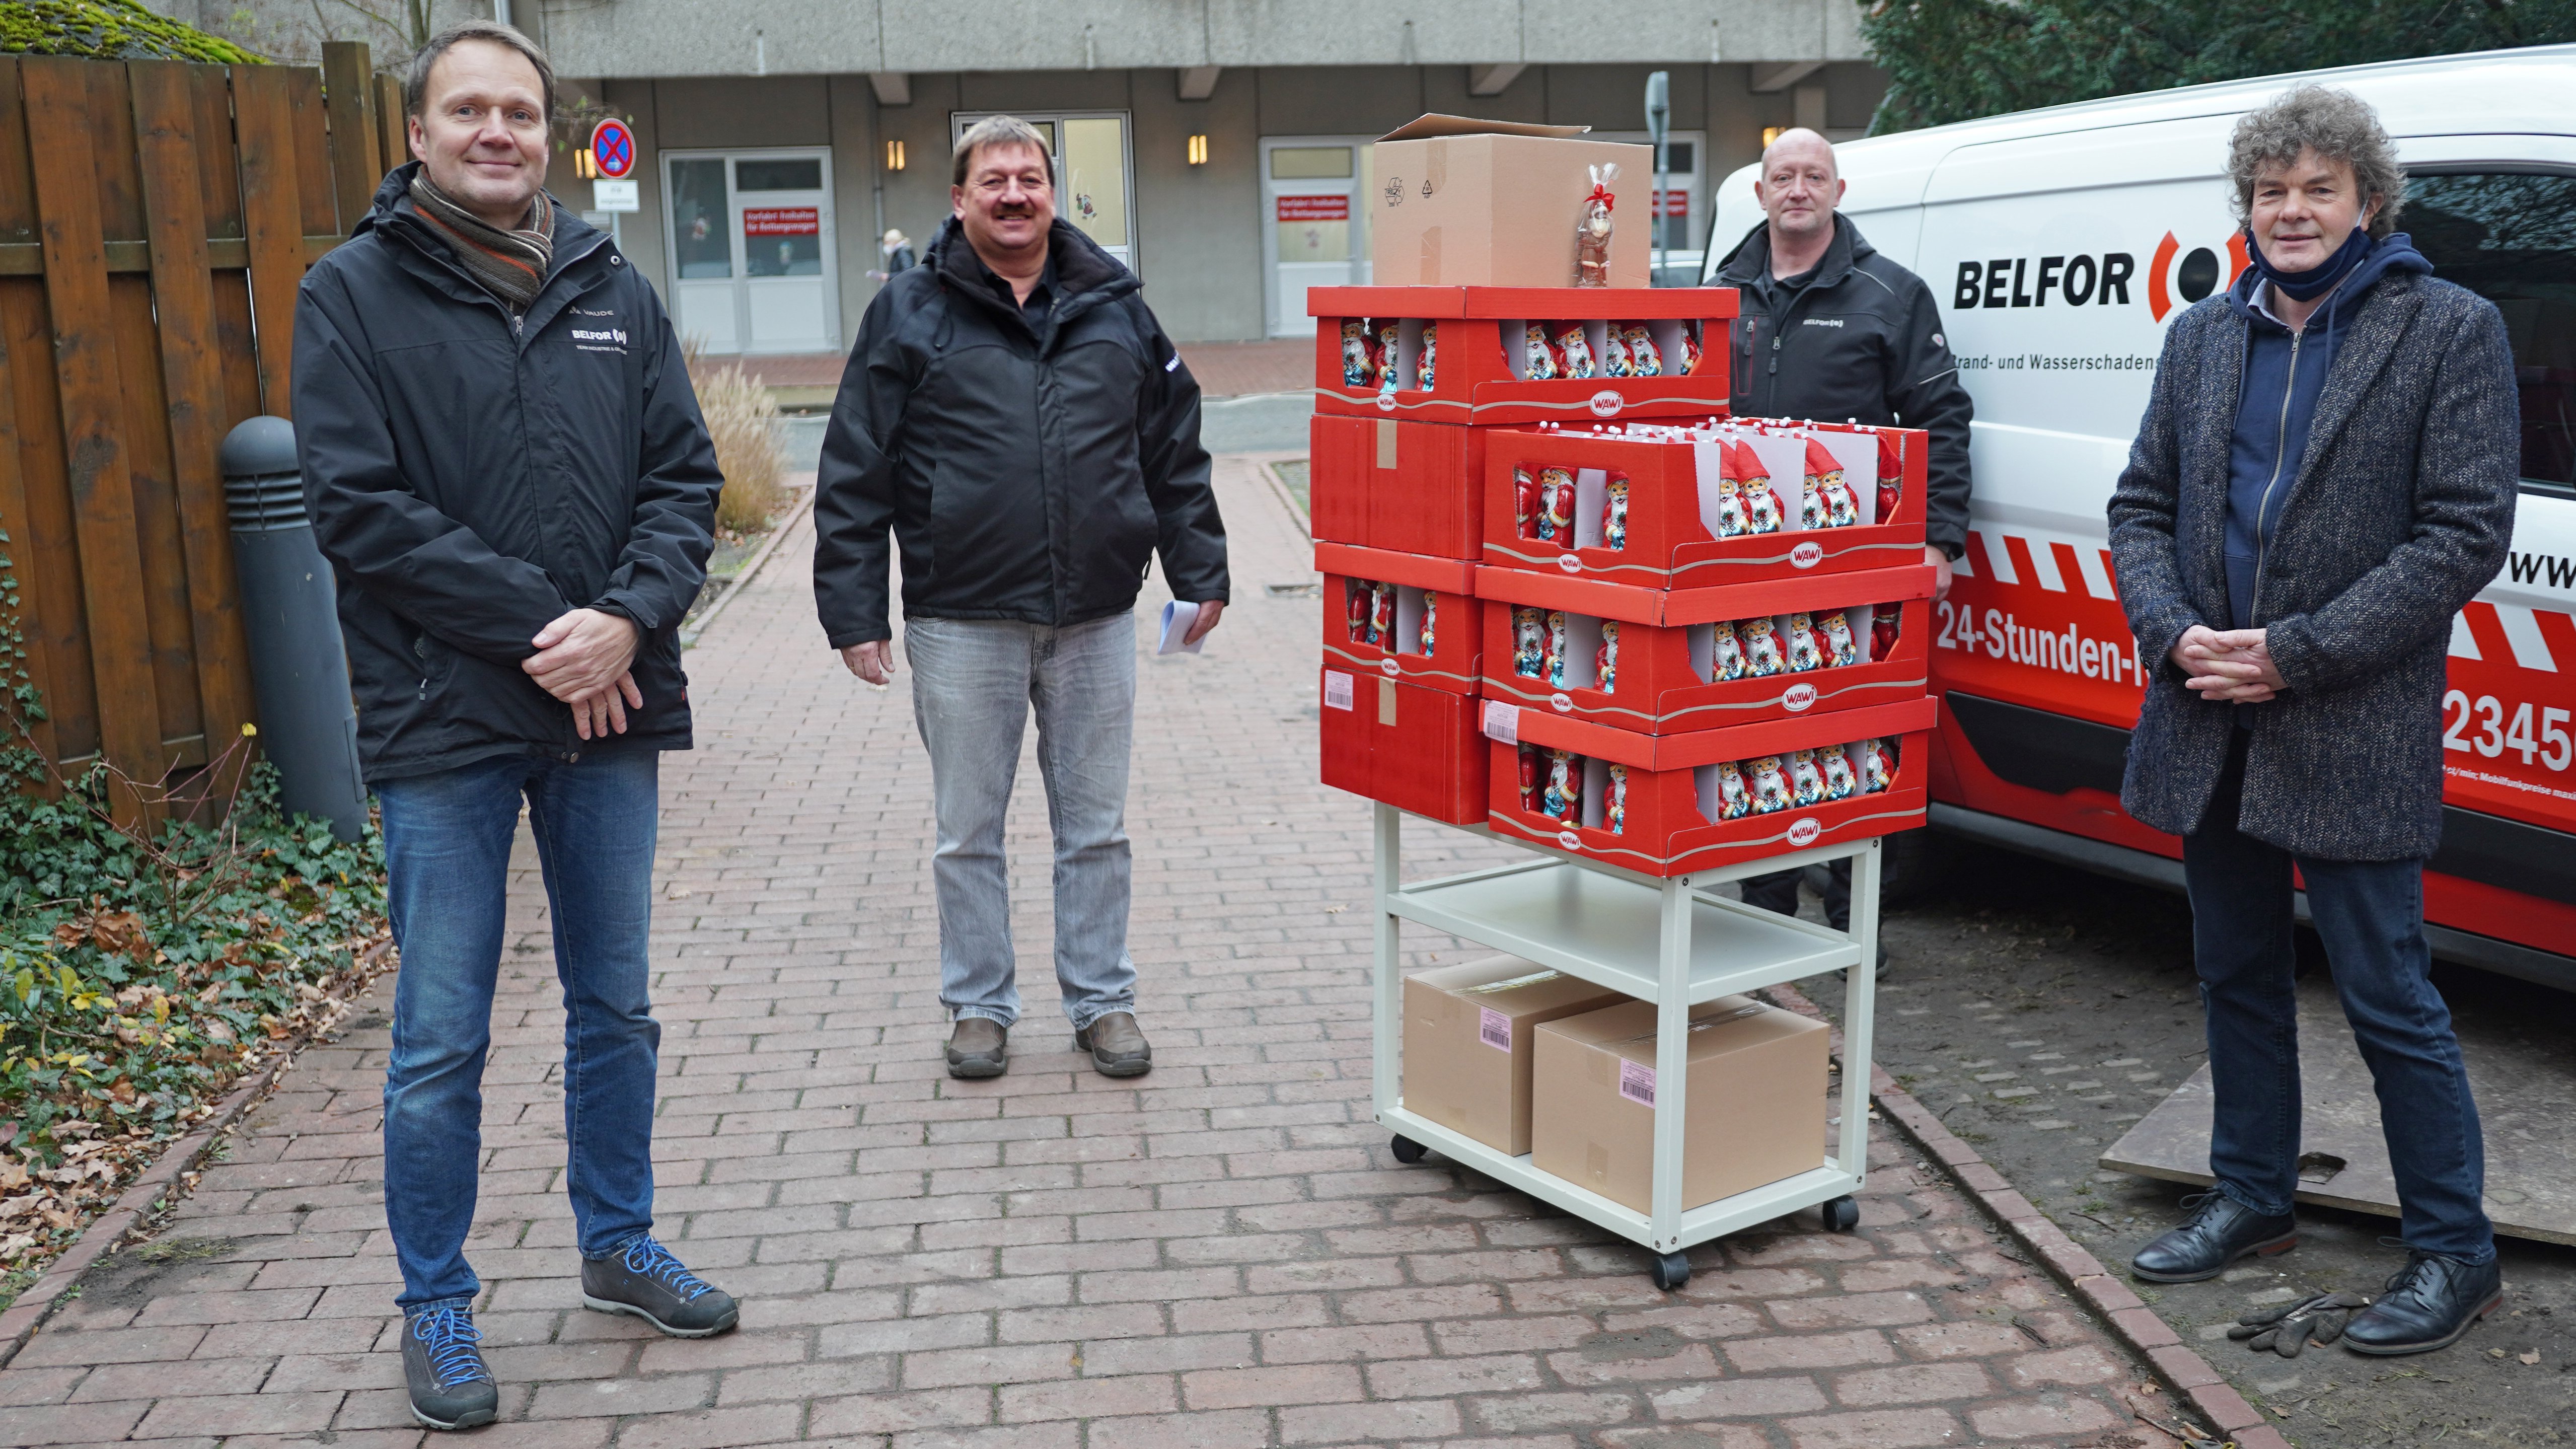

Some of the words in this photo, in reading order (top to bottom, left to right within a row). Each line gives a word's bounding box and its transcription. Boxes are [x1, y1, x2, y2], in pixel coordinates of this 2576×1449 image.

[1953, 252, 2135, 309] BELFOR
[571, 330, 613, 340] BELFOR
[1999, 354, 2024, 369] und
[2480, 772, 2552, 794] Mobilfunkpreise
